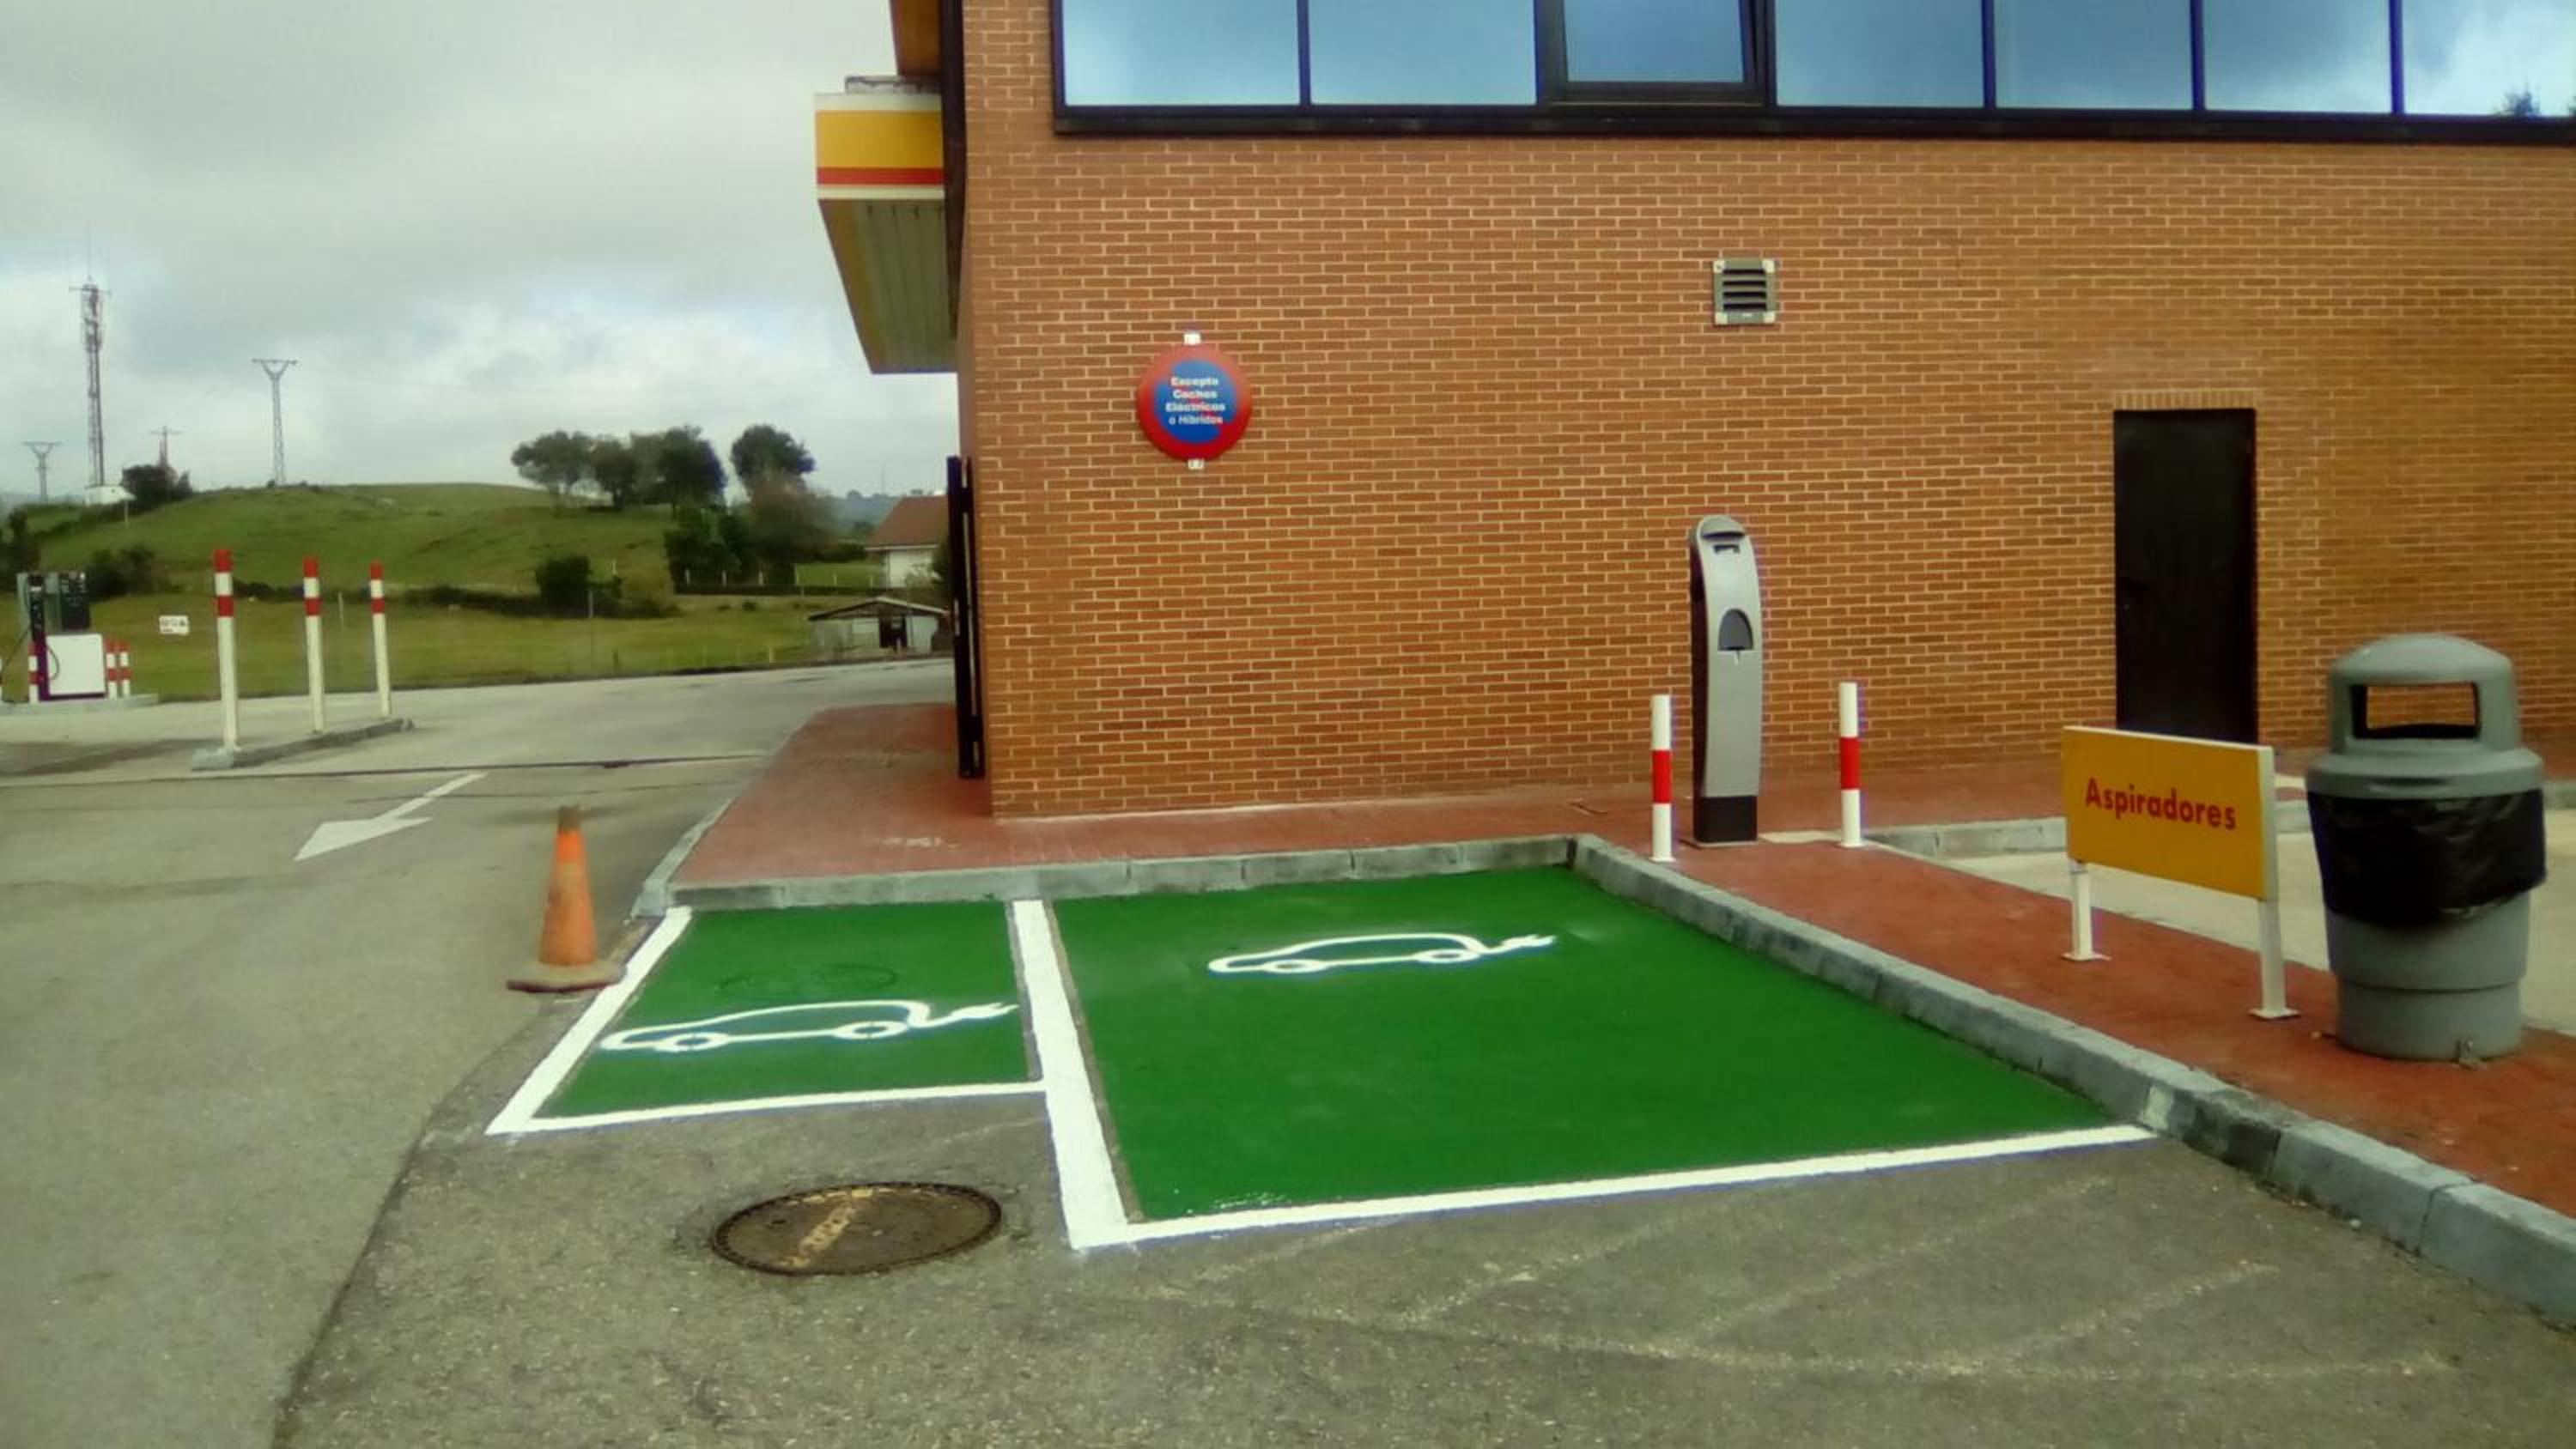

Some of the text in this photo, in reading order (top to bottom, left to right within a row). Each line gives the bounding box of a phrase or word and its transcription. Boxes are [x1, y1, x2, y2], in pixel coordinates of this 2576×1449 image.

[1170, 377, 1218, 387] Excepto
[1173, 389, 1218, 398] Coches
[1169, 416, 1176, 425] o
[2086, 777, 2237, 830] Aspiradores
